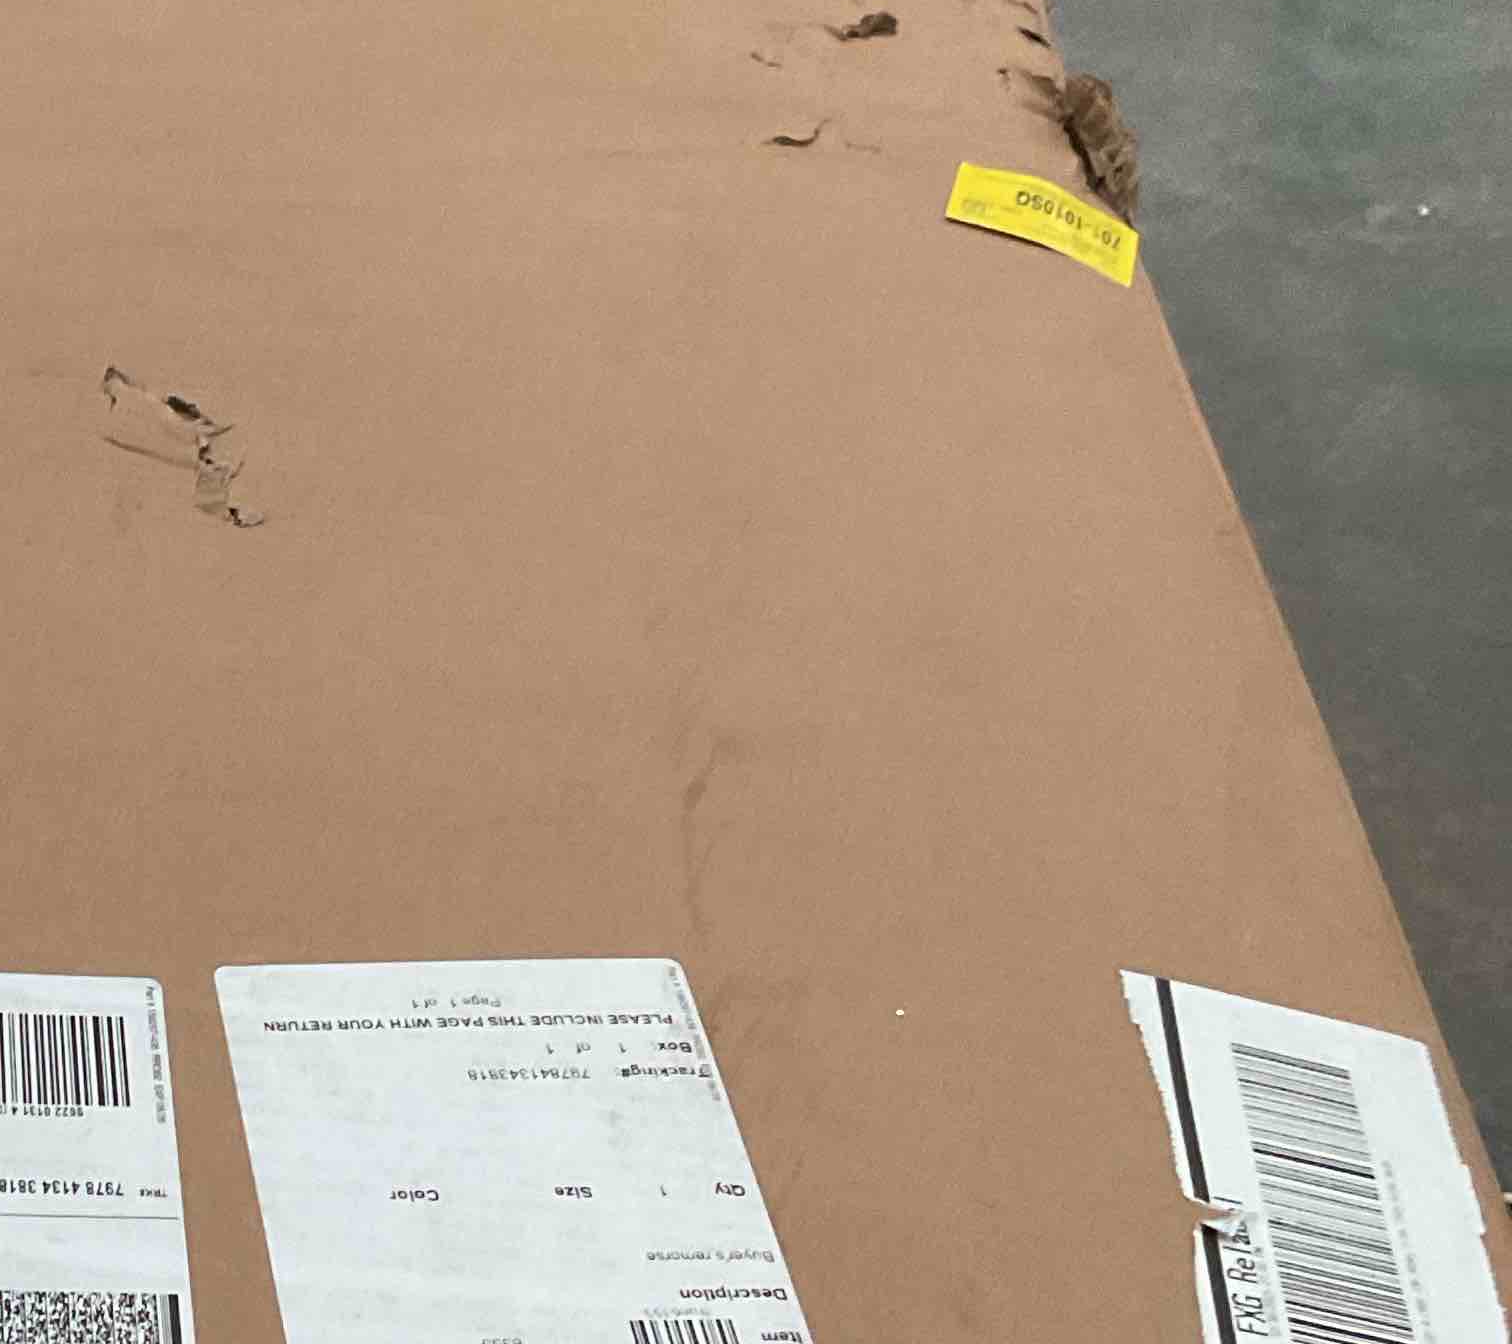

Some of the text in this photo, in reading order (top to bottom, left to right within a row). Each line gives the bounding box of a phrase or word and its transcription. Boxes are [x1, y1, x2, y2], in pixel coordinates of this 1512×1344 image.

[264, 1014, 672, 1032] PLEASE INCLUDE THIS PAGE WITH YOUR RETURN
[0, 1179, 37, 1194] 3818
[42, 1180, 81, 1196] 4134
[85, 1181, 123, 1197] 7978
[554, 1186, 593, 1199] Size
[714, 1183, 746, 1197] Qty
[389, 1190, 439, 1202] Color
[646, 1250, 775, 1264] Buyer's remorse
[680, 1286, 787, 1301] Description
[1232, 1295, 1269, 1337] FXG
[761, 1331, 802, 1344] Item
